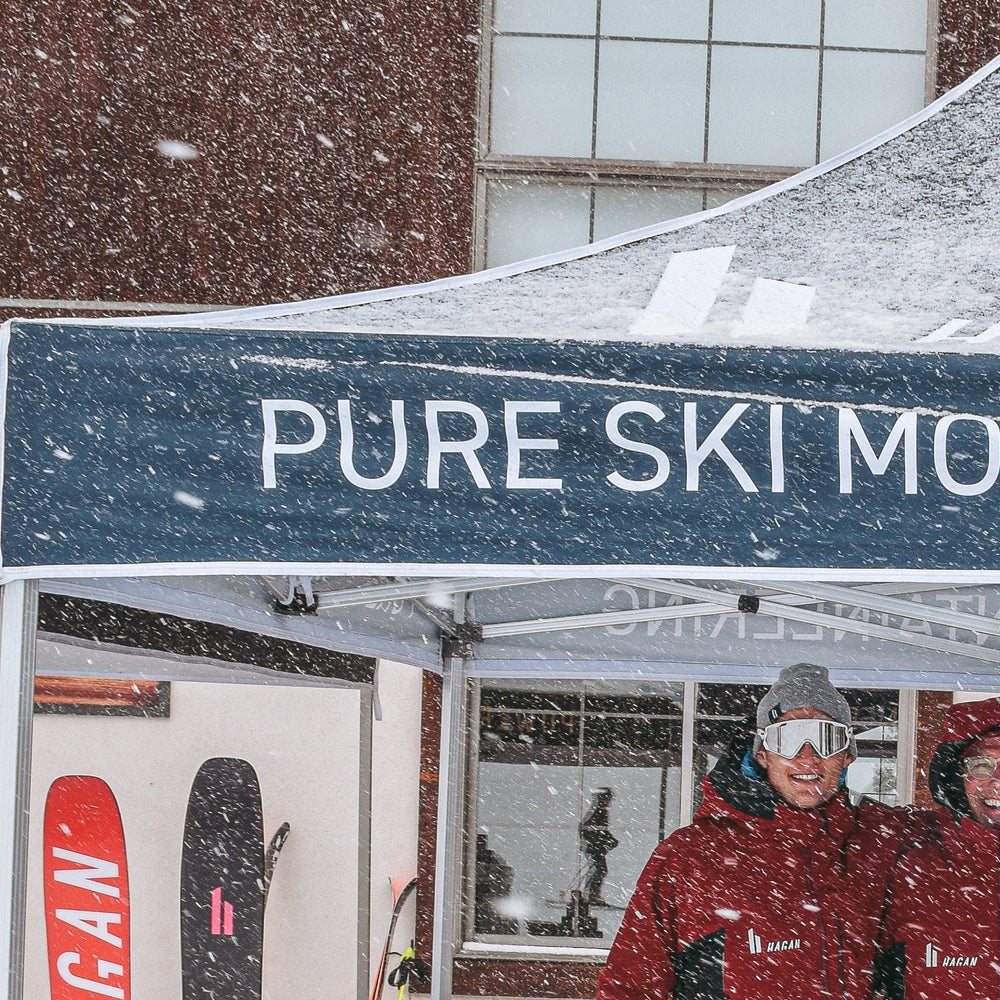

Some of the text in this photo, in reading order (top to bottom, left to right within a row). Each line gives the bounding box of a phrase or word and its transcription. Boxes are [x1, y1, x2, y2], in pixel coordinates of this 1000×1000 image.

[260, 399, 563, 490] PURE
[605, 400, 785, 494] SKI
[767, 938, 801, 952] HAGAN
[942, 956, 978, 967] HAGAN
